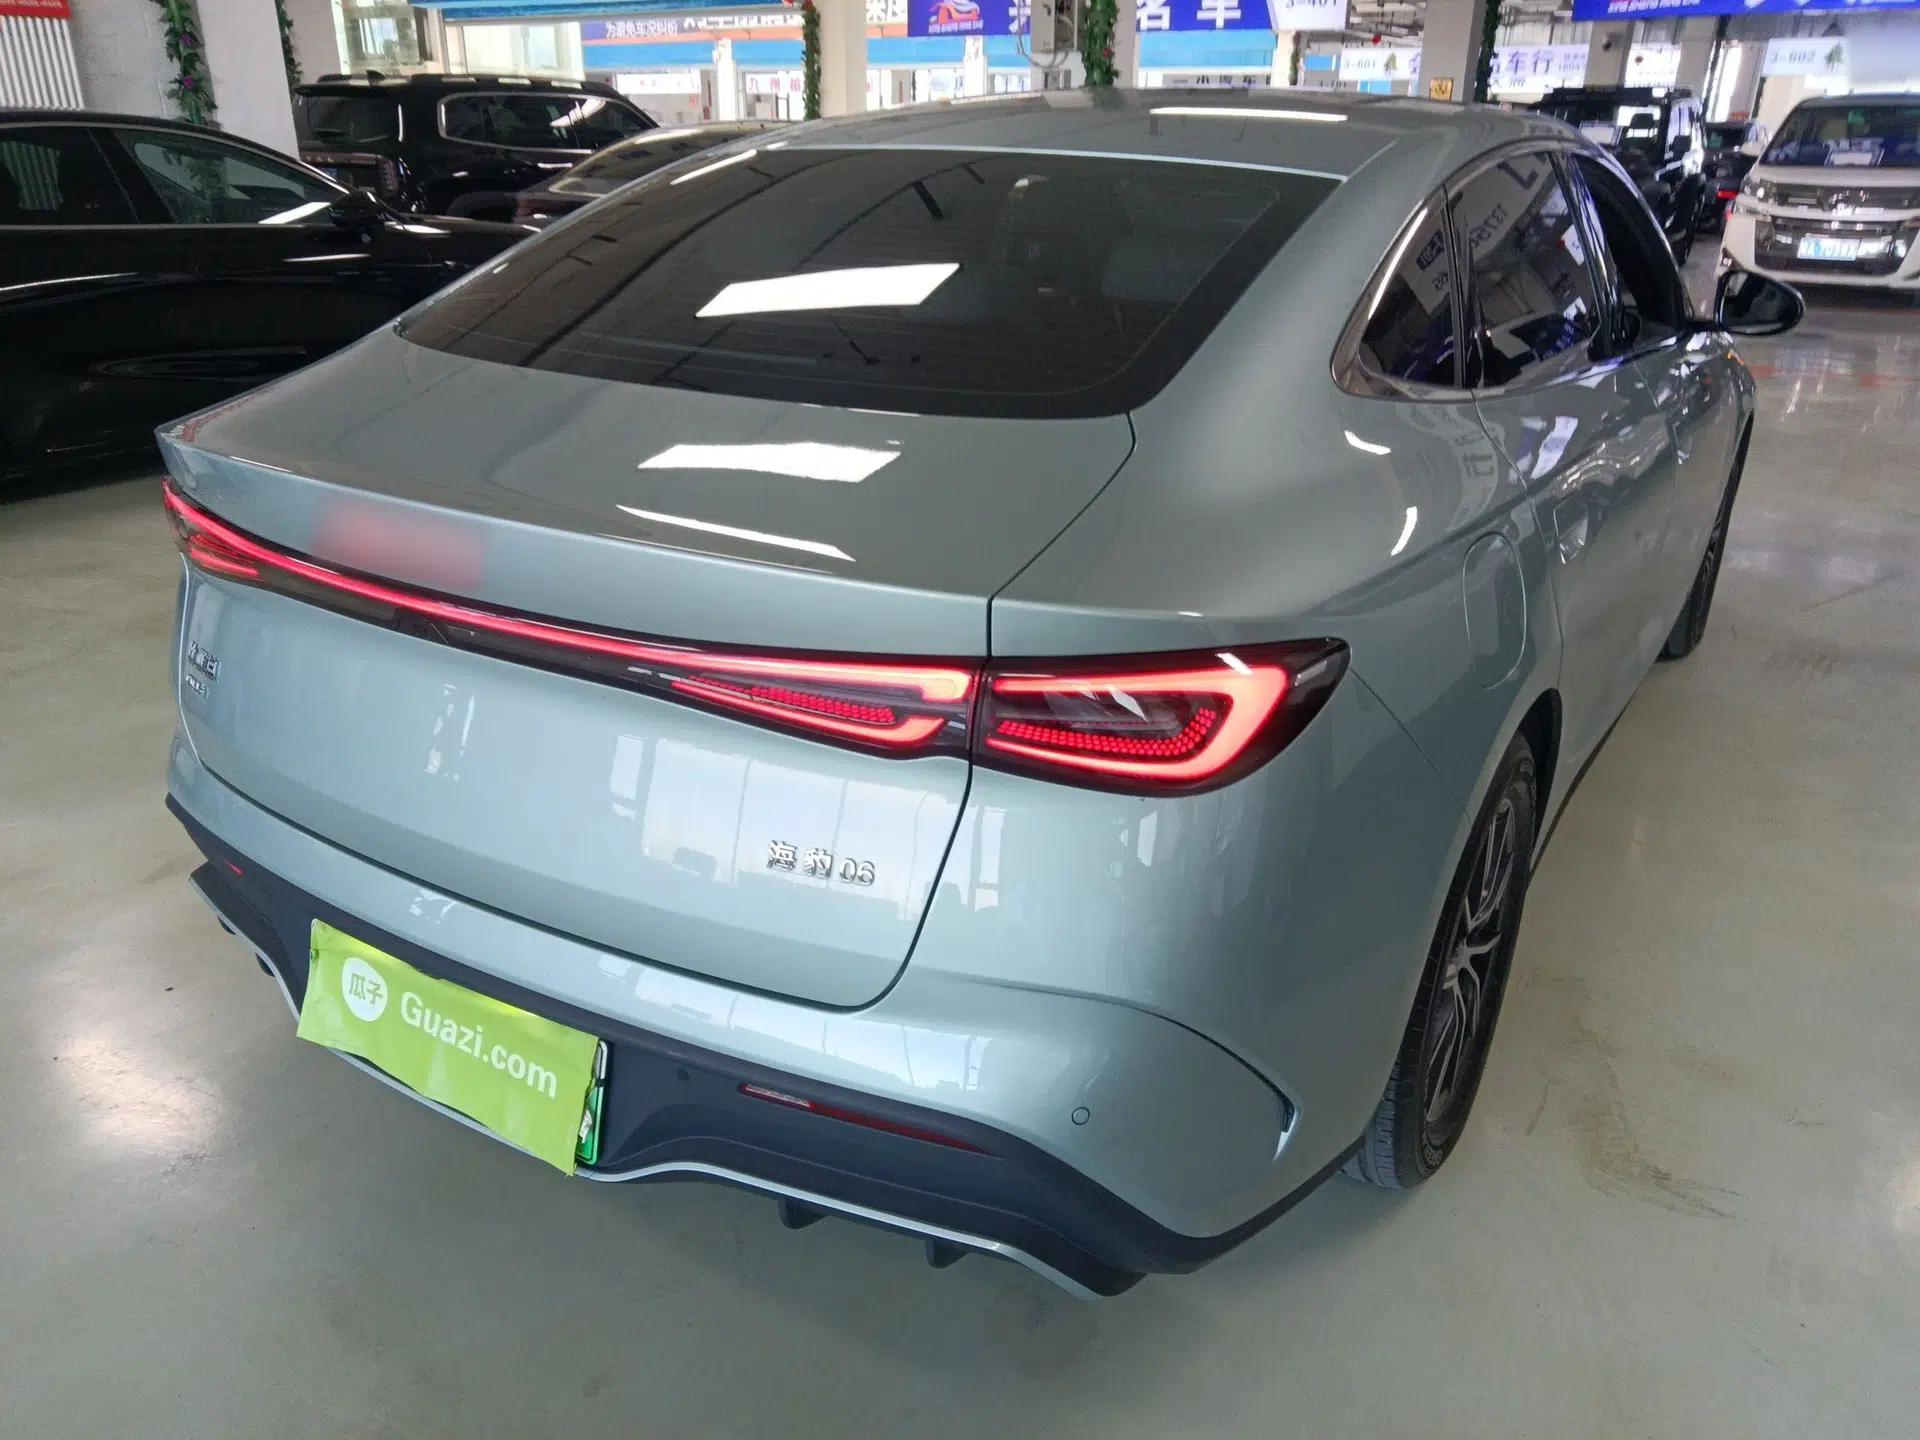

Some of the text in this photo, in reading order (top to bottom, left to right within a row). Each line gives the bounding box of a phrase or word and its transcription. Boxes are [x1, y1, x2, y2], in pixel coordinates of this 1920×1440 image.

[767, 840, 875, 886] 海豹06
[349, 971, 383, 1005] 瓜子
[401, 991, 557, 1100] Guazi.com
